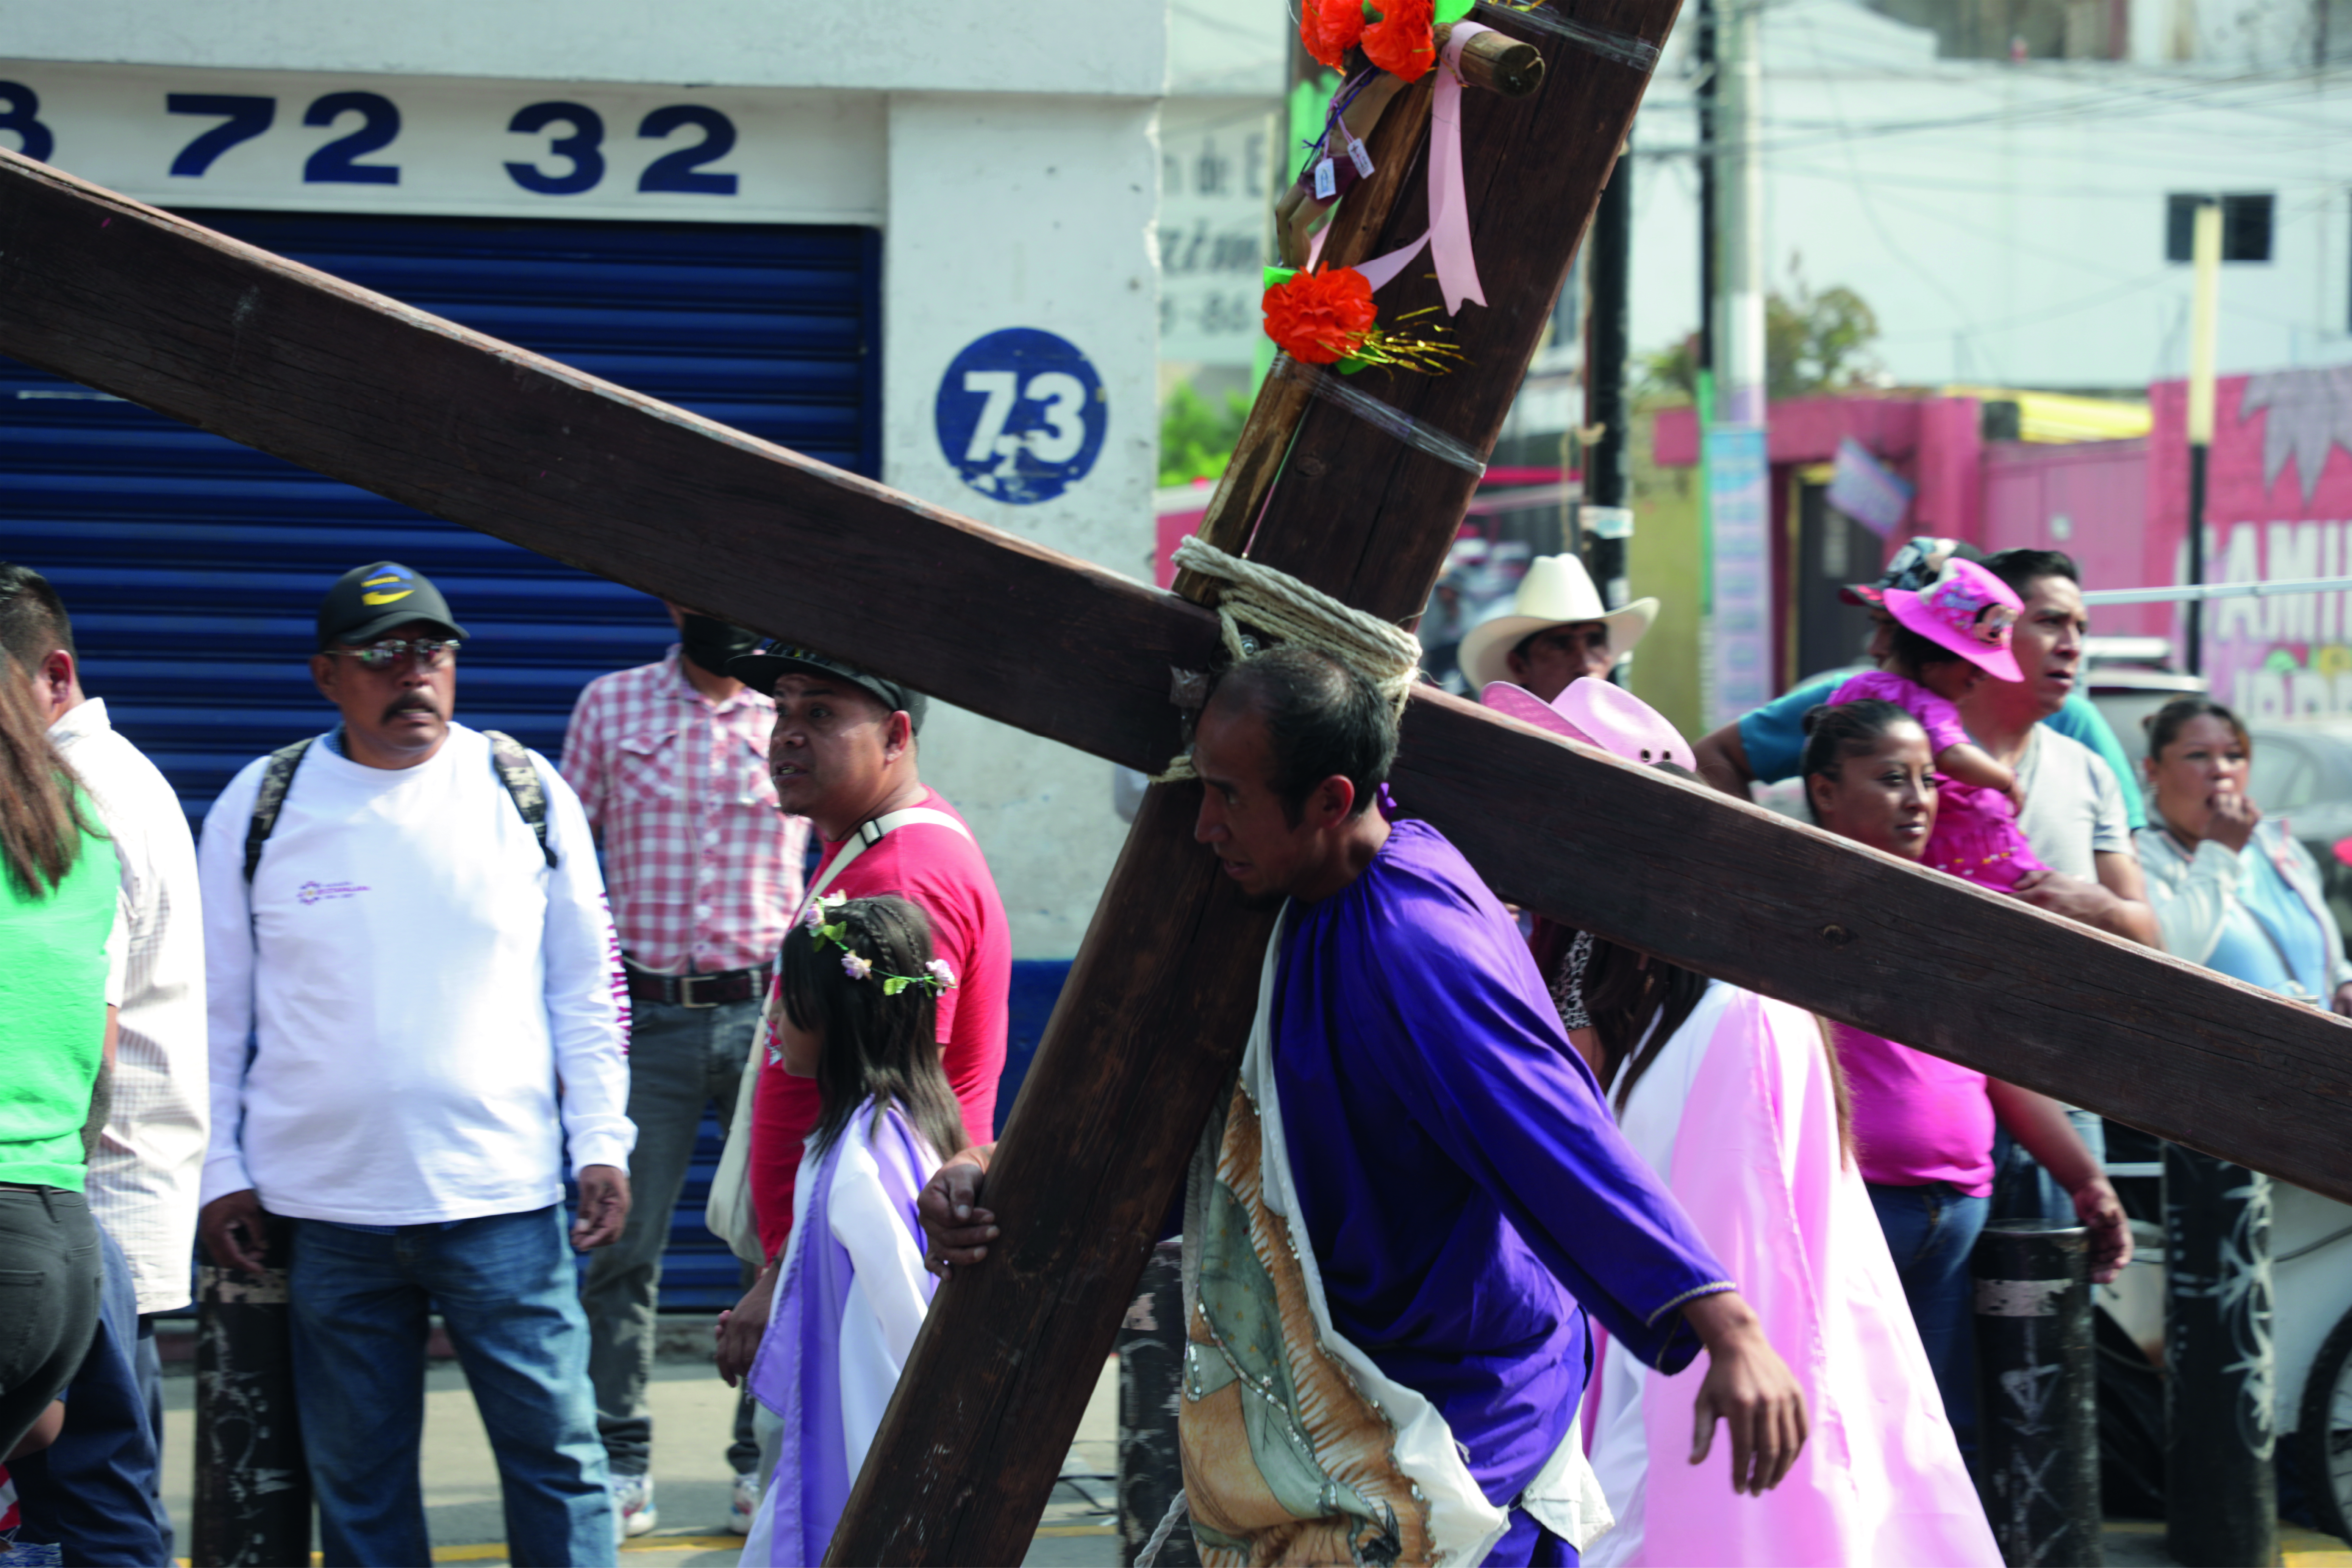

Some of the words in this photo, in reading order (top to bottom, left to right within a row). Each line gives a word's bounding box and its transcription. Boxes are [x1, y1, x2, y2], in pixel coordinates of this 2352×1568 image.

[166, 91, 402, 185] 72
[503, 101, 739, 196] 32
[963, 370, 1087, 464] 73
